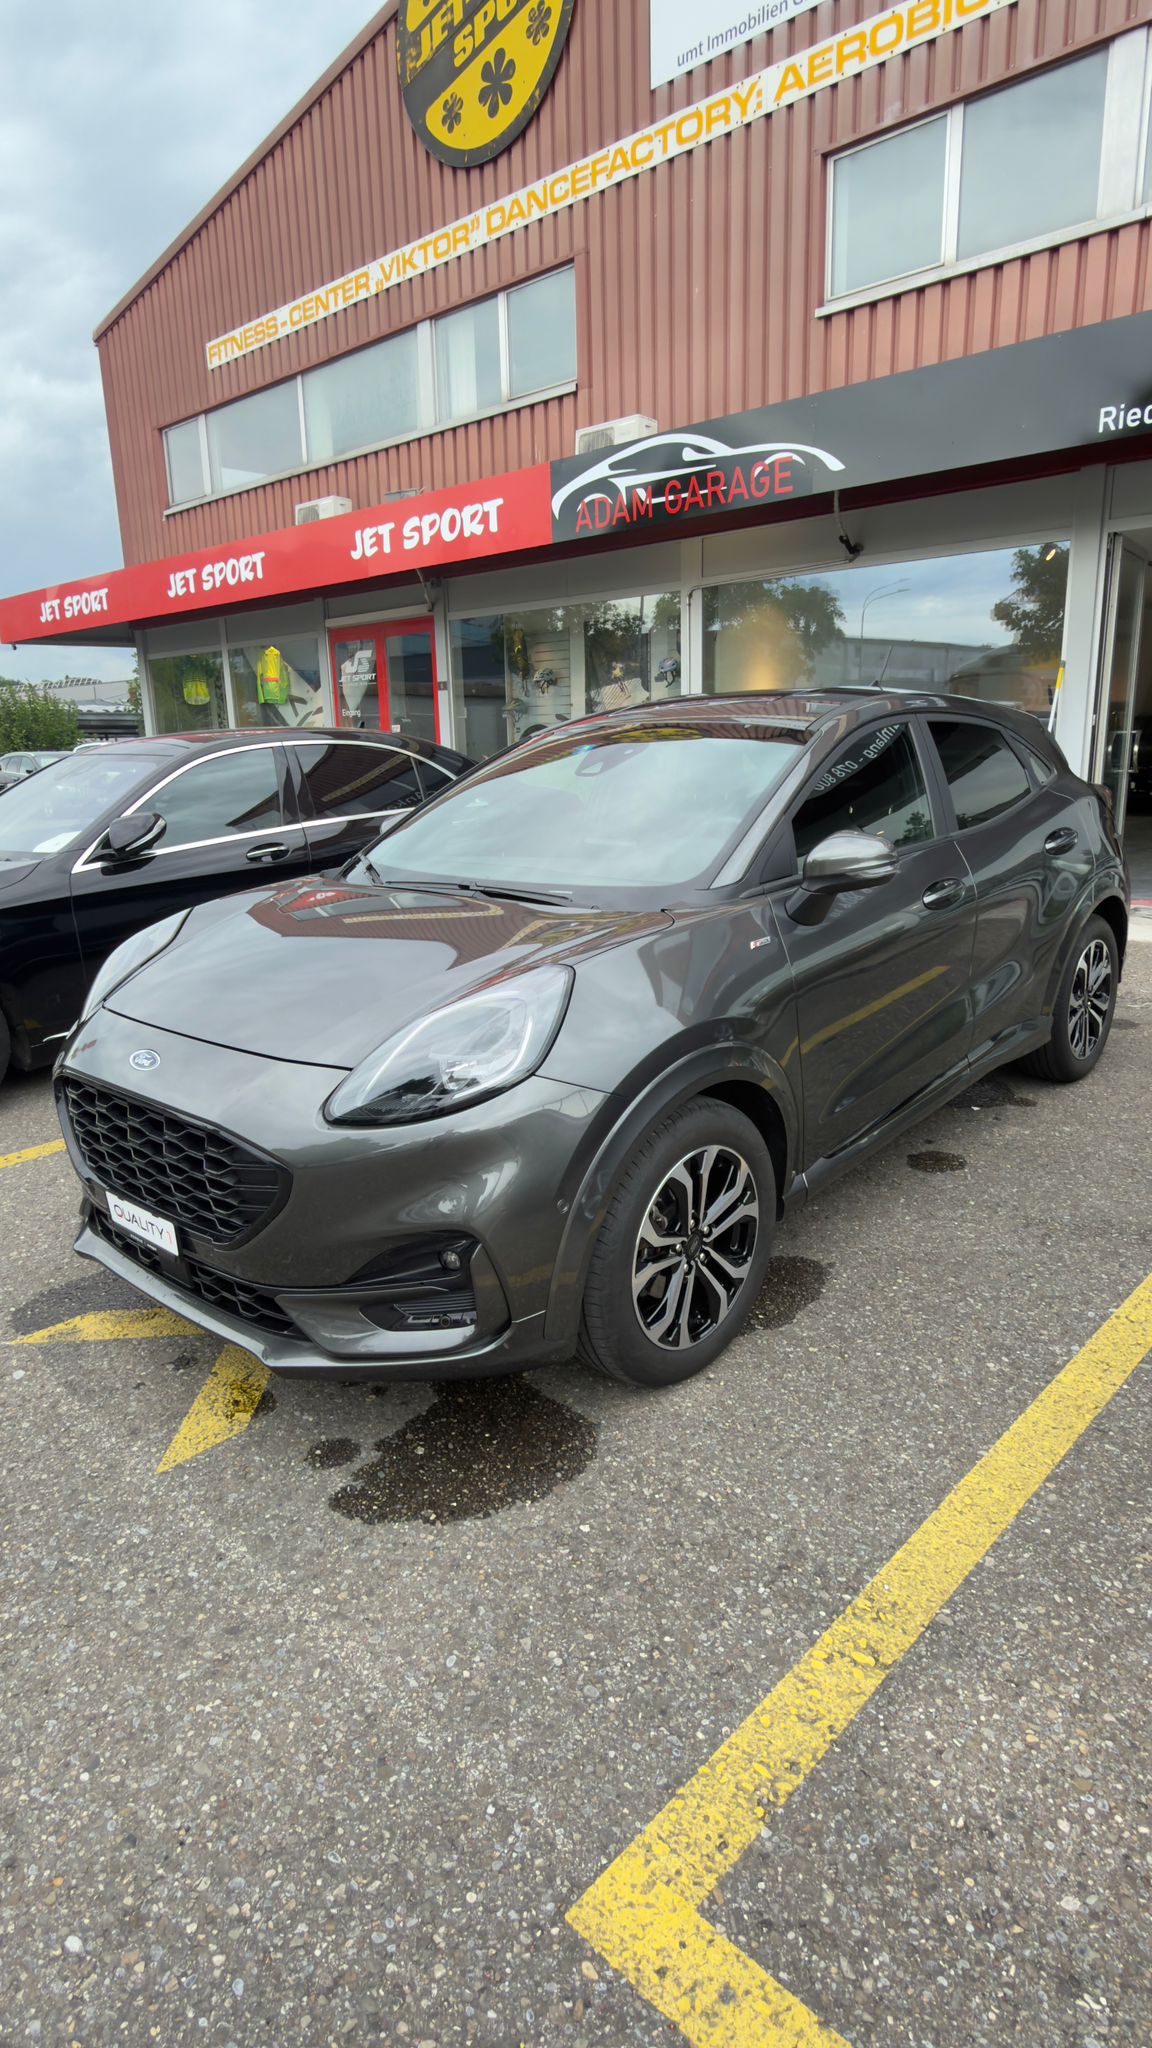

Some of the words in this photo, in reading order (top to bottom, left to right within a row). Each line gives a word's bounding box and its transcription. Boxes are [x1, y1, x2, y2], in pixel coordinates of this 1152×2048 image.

[676, 41, 703, 67] umt
[707, 0, 789, 52] Immobilien
[575, 485, 653, 534] ADAM
[663, 455, 795, 515] GARAGE
[350, 521, 396, 560] JET
[402, 497, 504, 550] SPORT
[39, 598, 61, 623] JET
[63, 587, 109, 619] SPORT
[166, 568, 197, 598] JET
[201, 551, 266, 591] SPORT
